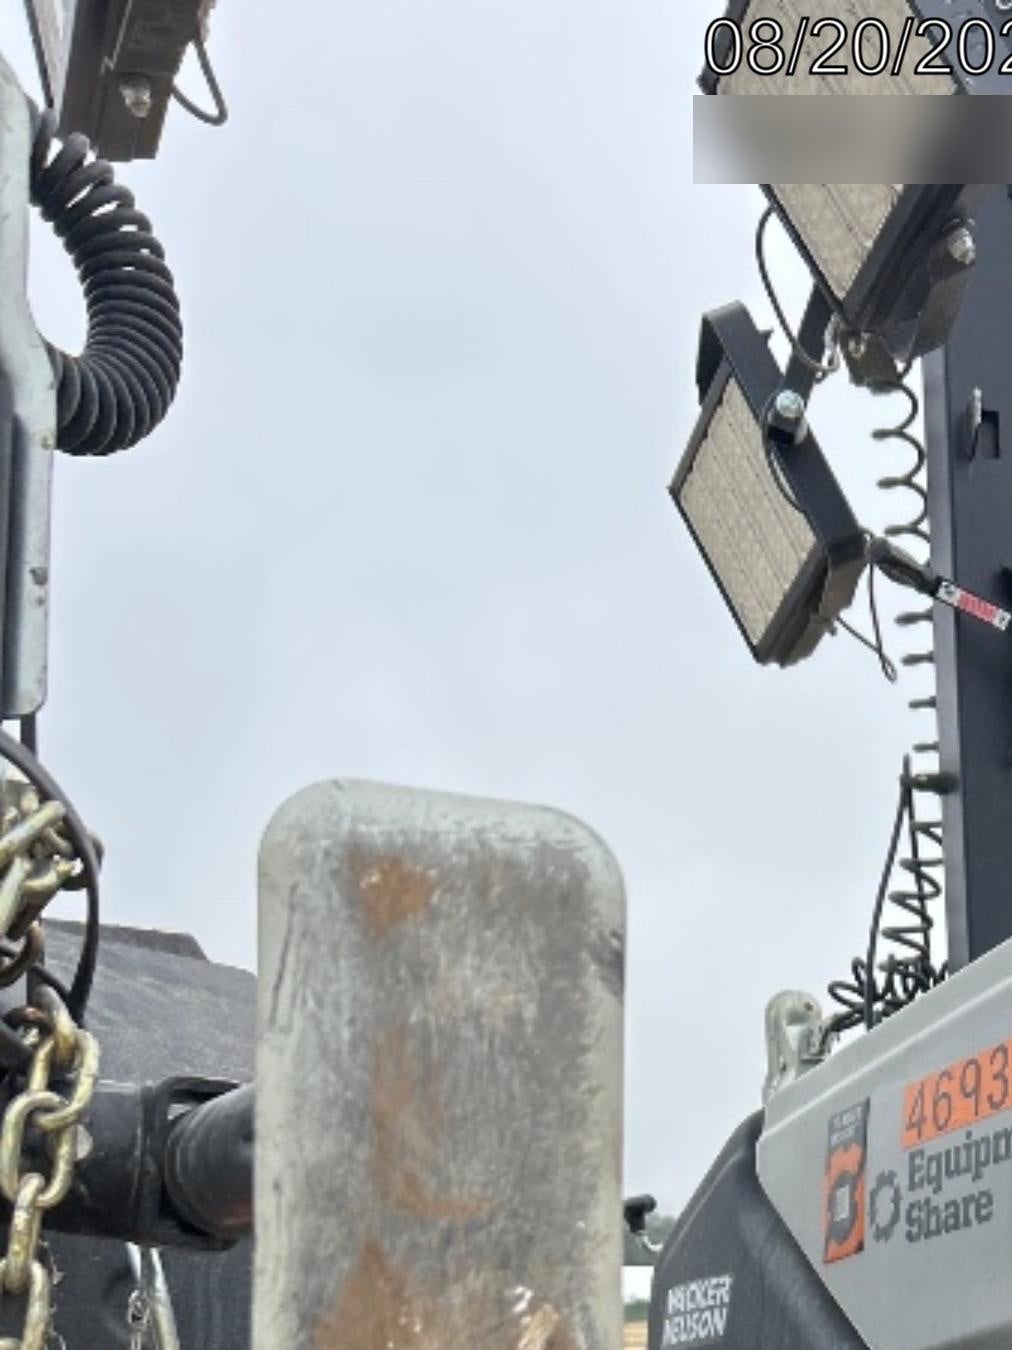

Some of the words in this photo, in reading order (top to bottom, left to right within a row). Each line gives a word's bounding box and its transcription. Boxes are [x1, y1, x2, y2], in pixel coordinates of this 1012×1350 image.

[904, 1187, 995, 1244] Share
[667, 1275, 732, 1315] WACKER
[662, 1306, 727, 1346] NELSON
